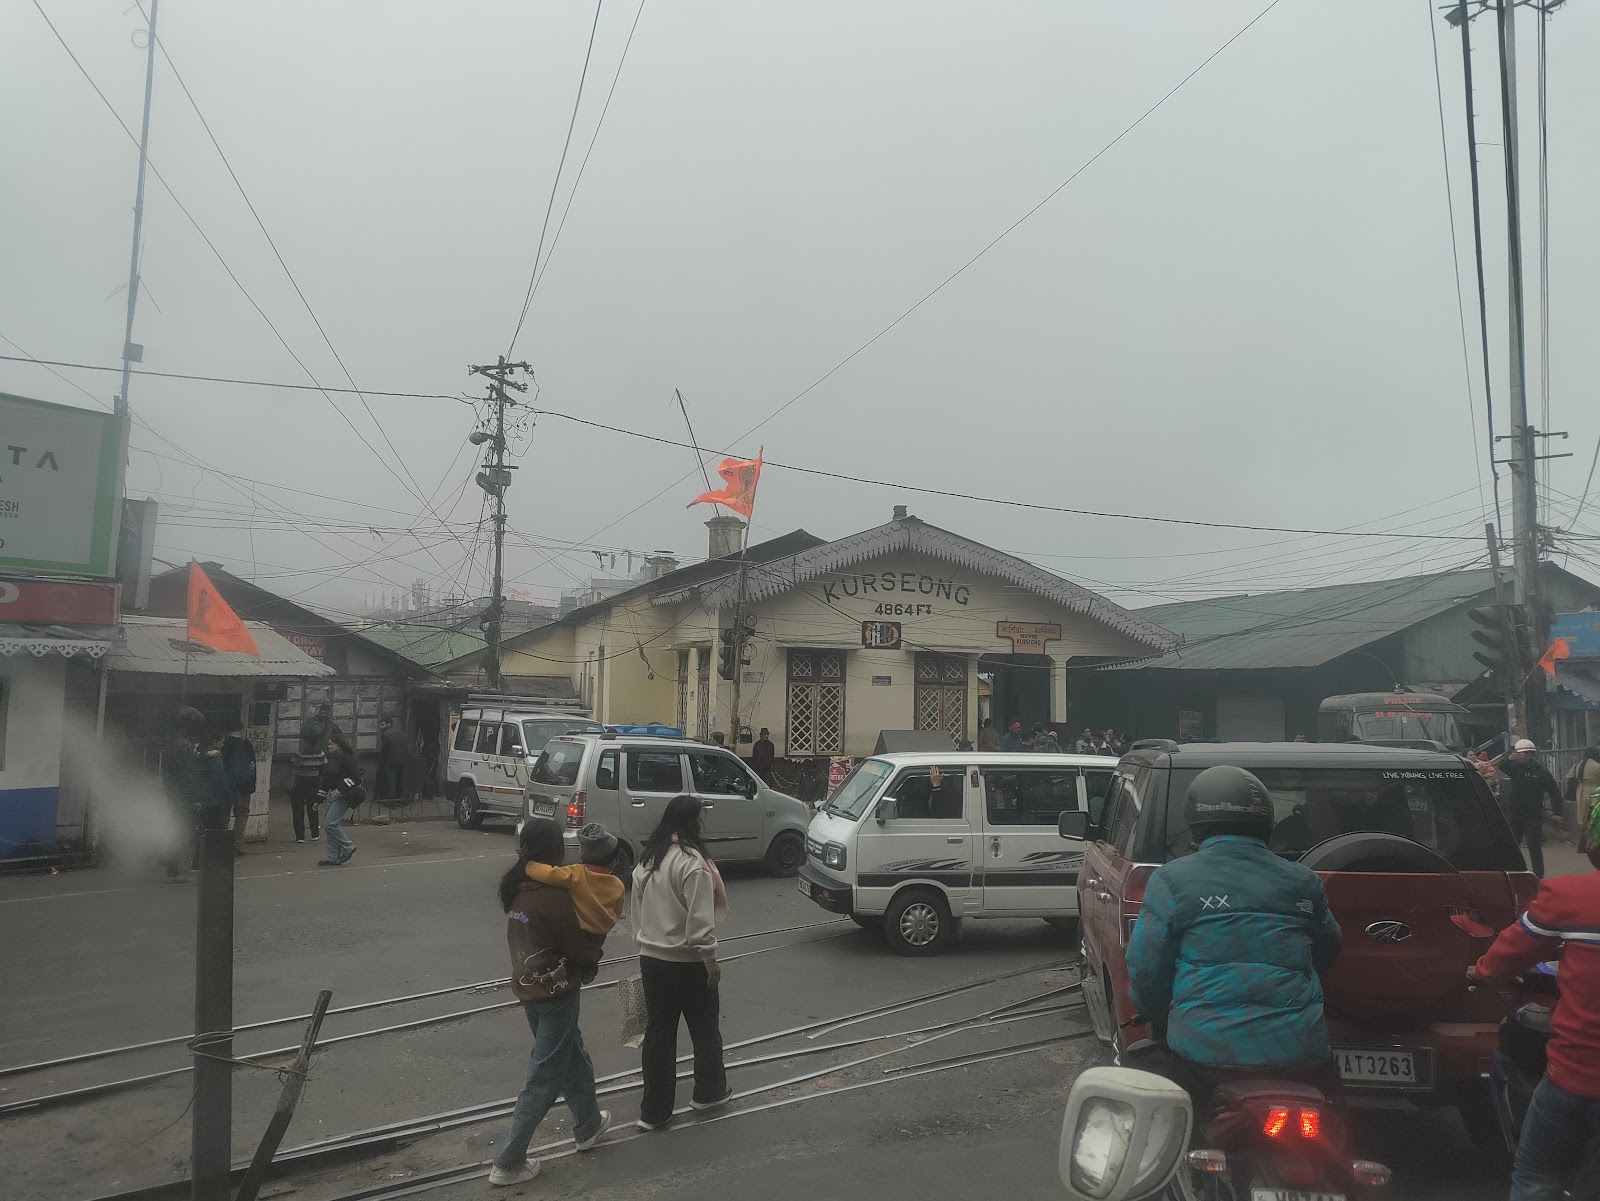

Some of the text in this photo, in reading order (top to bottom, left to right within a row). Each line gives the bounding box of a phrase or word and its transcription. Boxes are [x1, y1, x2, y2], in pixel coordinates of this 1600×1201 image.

[823, 571, 970, 606] KURSEONG
[874, 603, 913, 616] 4864
[294, 636, 321, 645] DROP
